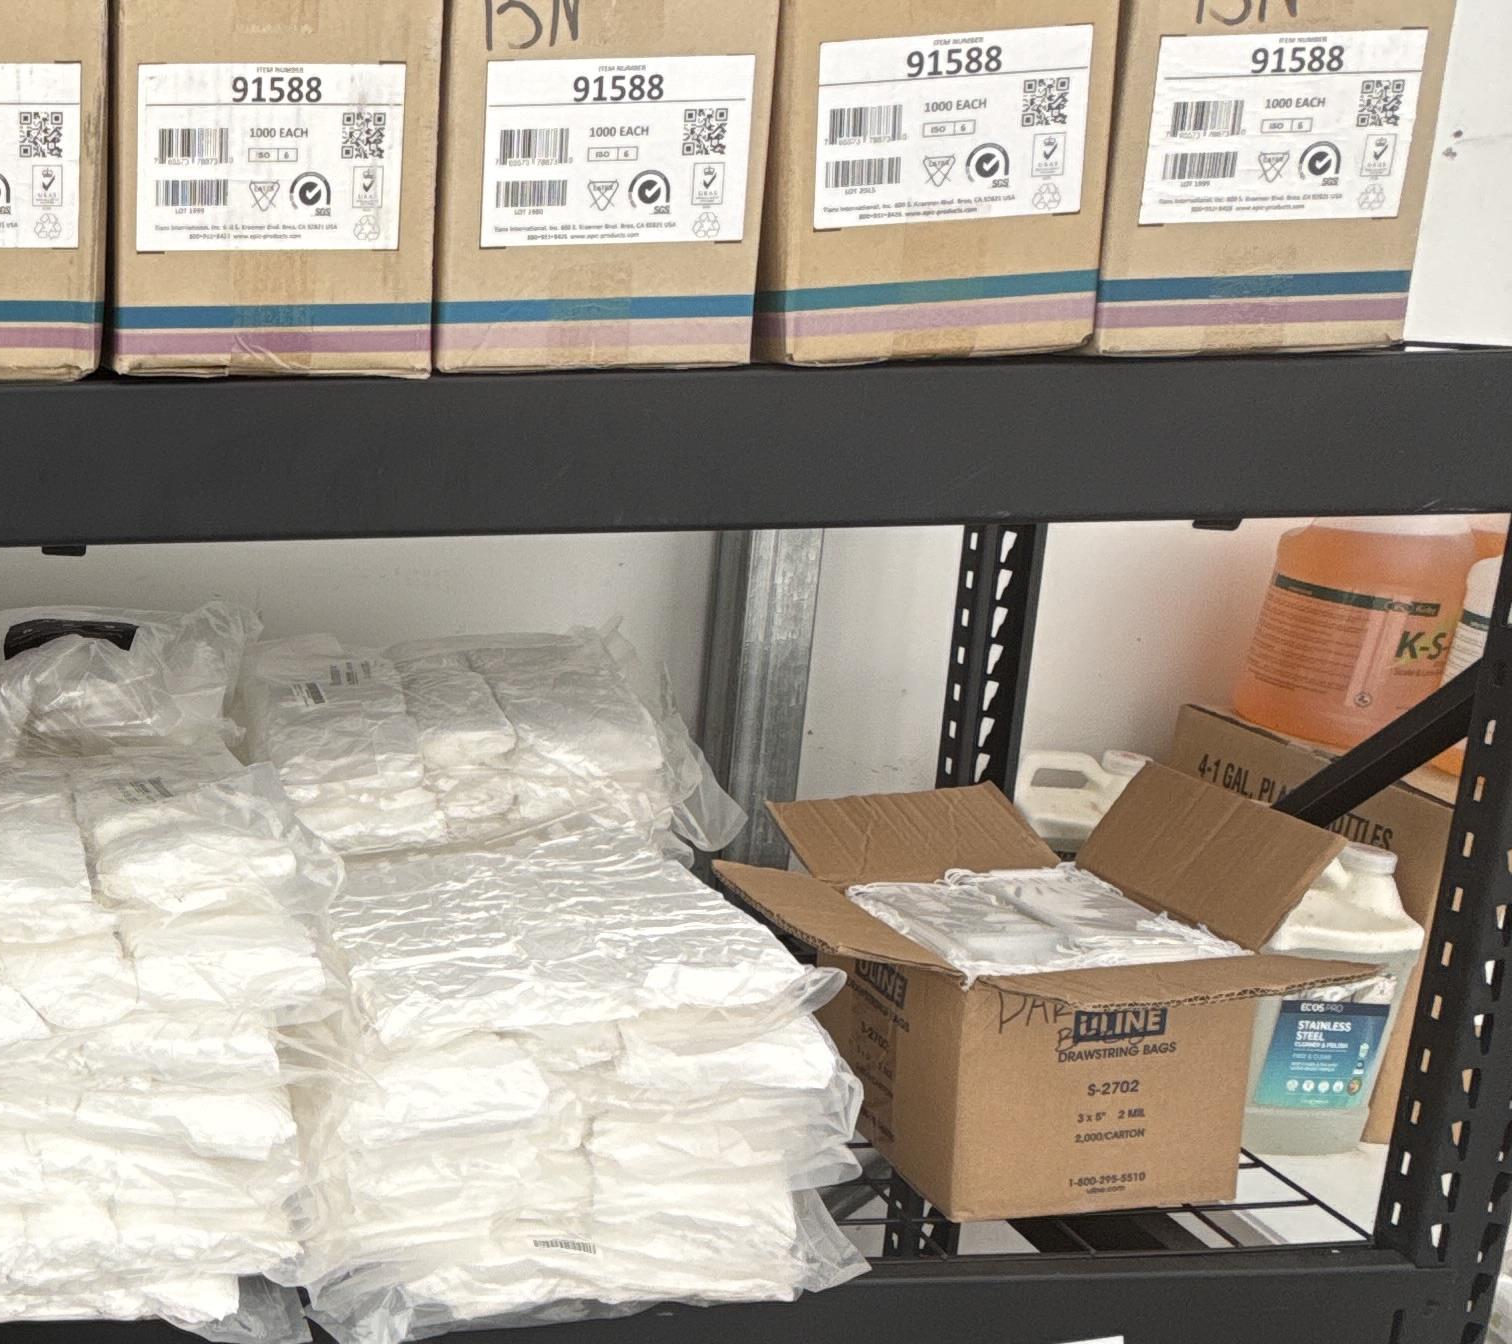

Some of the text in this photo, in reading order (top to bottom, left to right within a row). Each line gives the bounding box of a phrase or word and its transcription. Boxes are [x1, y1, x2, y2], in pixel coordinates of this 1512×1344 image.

[907, 46, 1002, 77] 91588
[1251, 46, 1344, 73] 91588
[232, 77, 321, 102] 91588
[573, 74, 664, 101] 91588
[925, 99, 987, 113] 1000 EACH
[1265, 97, 1326, 109] 1000 EACH
[250, 128, 308, 138] 1000 EACH
[590, 126, 649, 137] 1000 EACH
[1197, 753, 1221, 783] 4-1
[1300, 1003, 1325, 1013] ECOS
[1298, 1020, 1352, 1032] STAINLESS
[1295, 1031, 1325, 1042] STEEL
[1058, 1042, 1176, 1063] DRAWSTRING BAGS
[1087, 1080, 1140, 1096] S-2702
